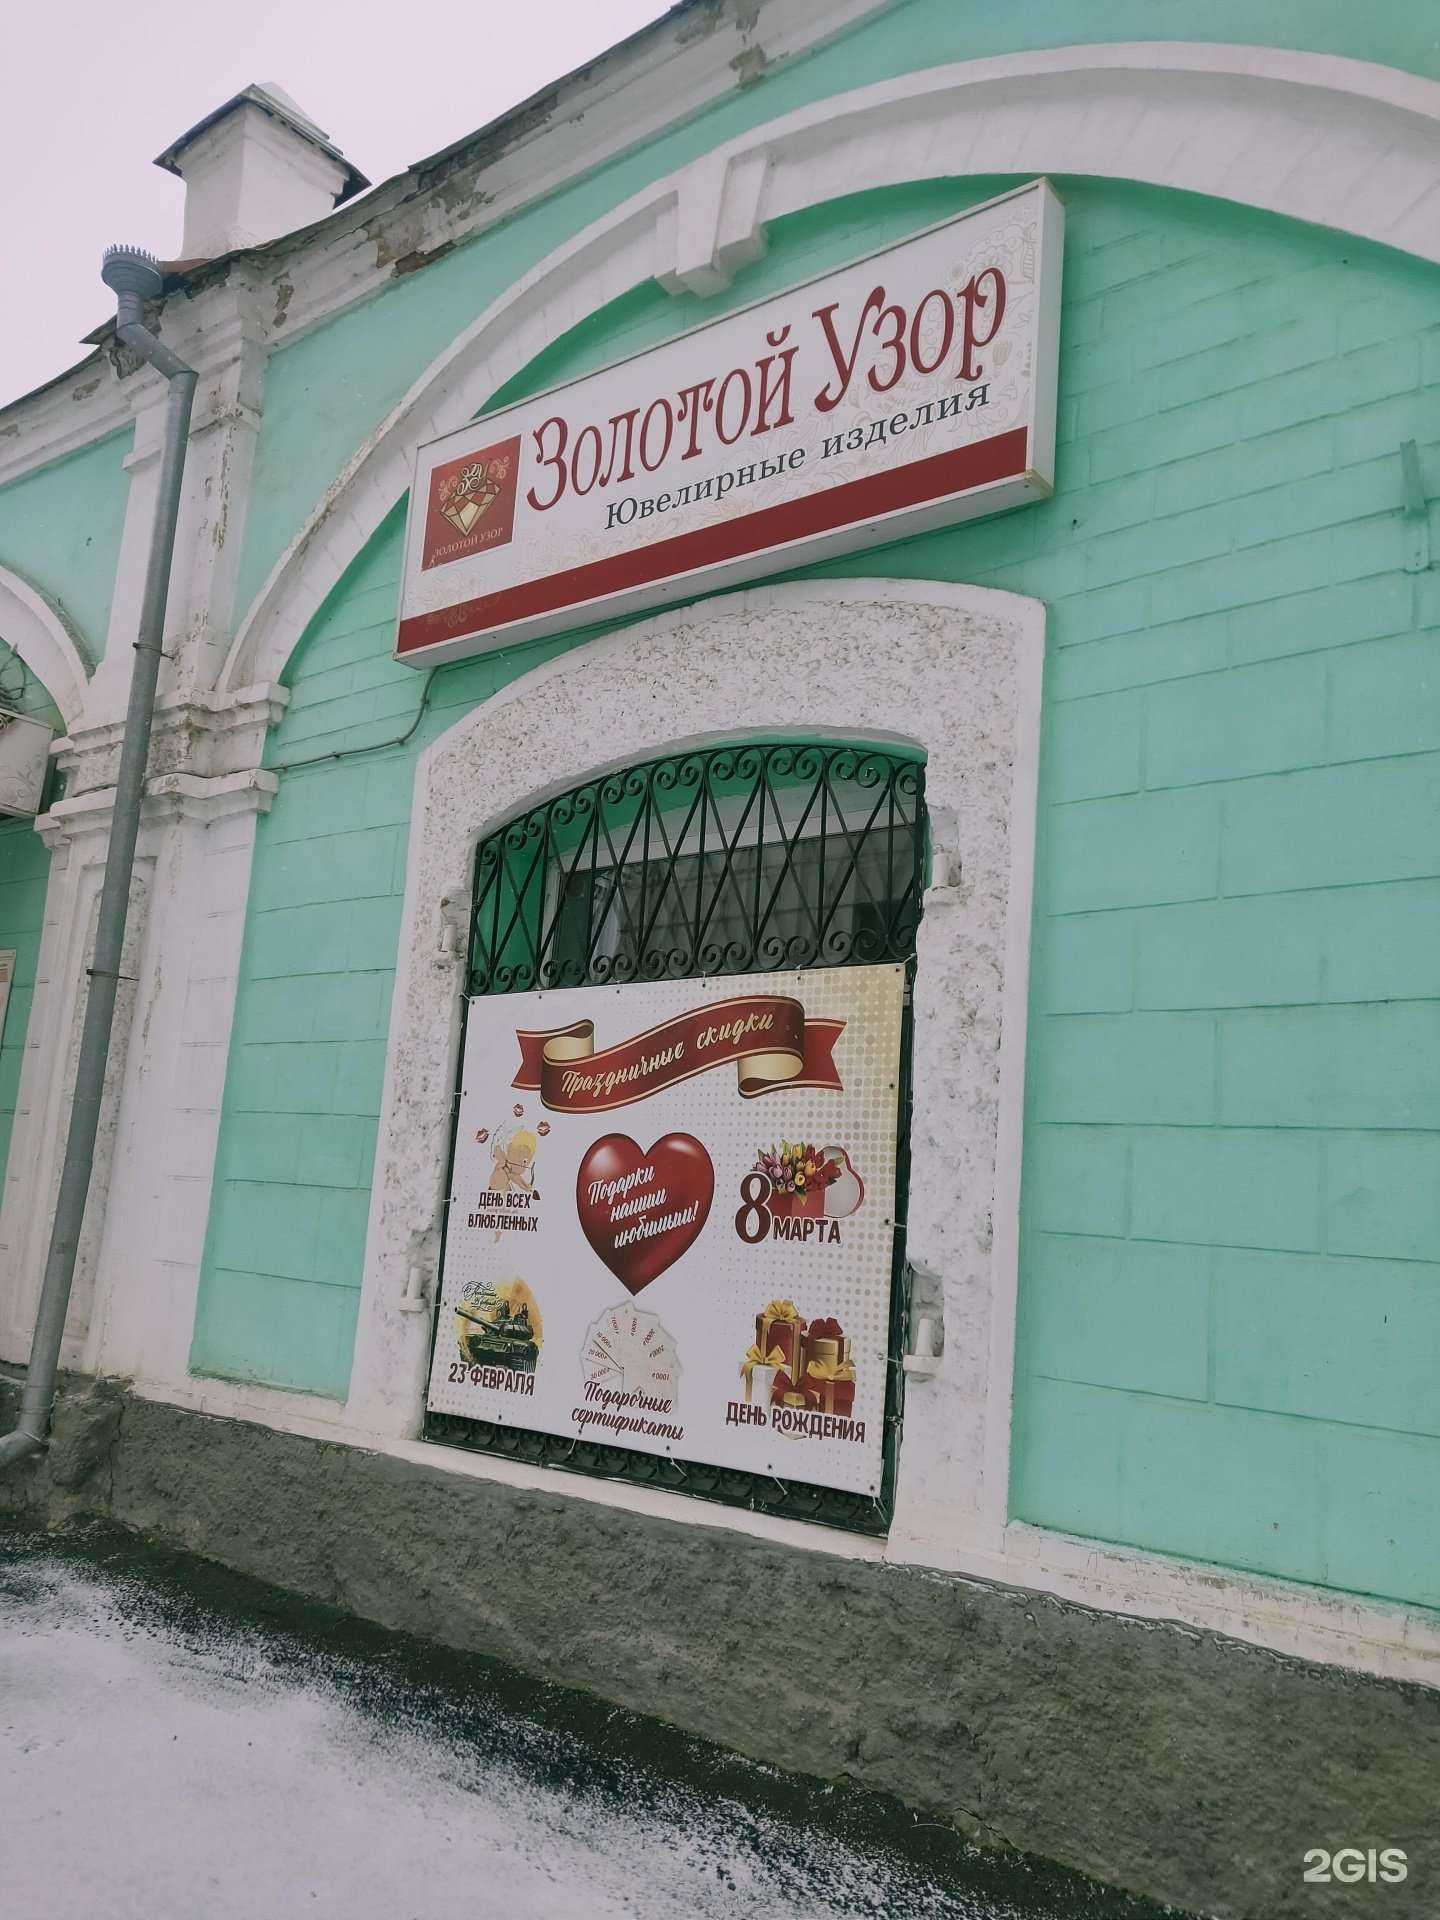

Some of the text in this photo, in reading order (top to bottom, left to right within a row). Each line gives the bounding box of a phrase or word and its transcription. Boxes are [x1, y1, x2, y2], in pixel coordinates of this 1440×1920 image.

[526, 267, 1006, 511] Золотой Узор
[605, 383, 990, 529] Ювелирные изделия
[562, 1013, 773, 1098] Праздничные скидки
[478, 1192, 531, 1209] ДЕНЬ ВСЕХ
[588, 1166, 655, 1205] Подарки
[468, 1213, 538, 1231] ВЛЮБЛЕННЫХ
[735, 1173, 841, 1244] 8 МАРТА
[448, 1362, 535, 1395] 23 ФЕВРАЛЯ
[584, 1381, 673, 1413] Подарочные
[572, 1408, 684, 1440] сертификаты
[726, 1402, 866, 1443] ДЕНЬ РОЖДЕНИЯ
